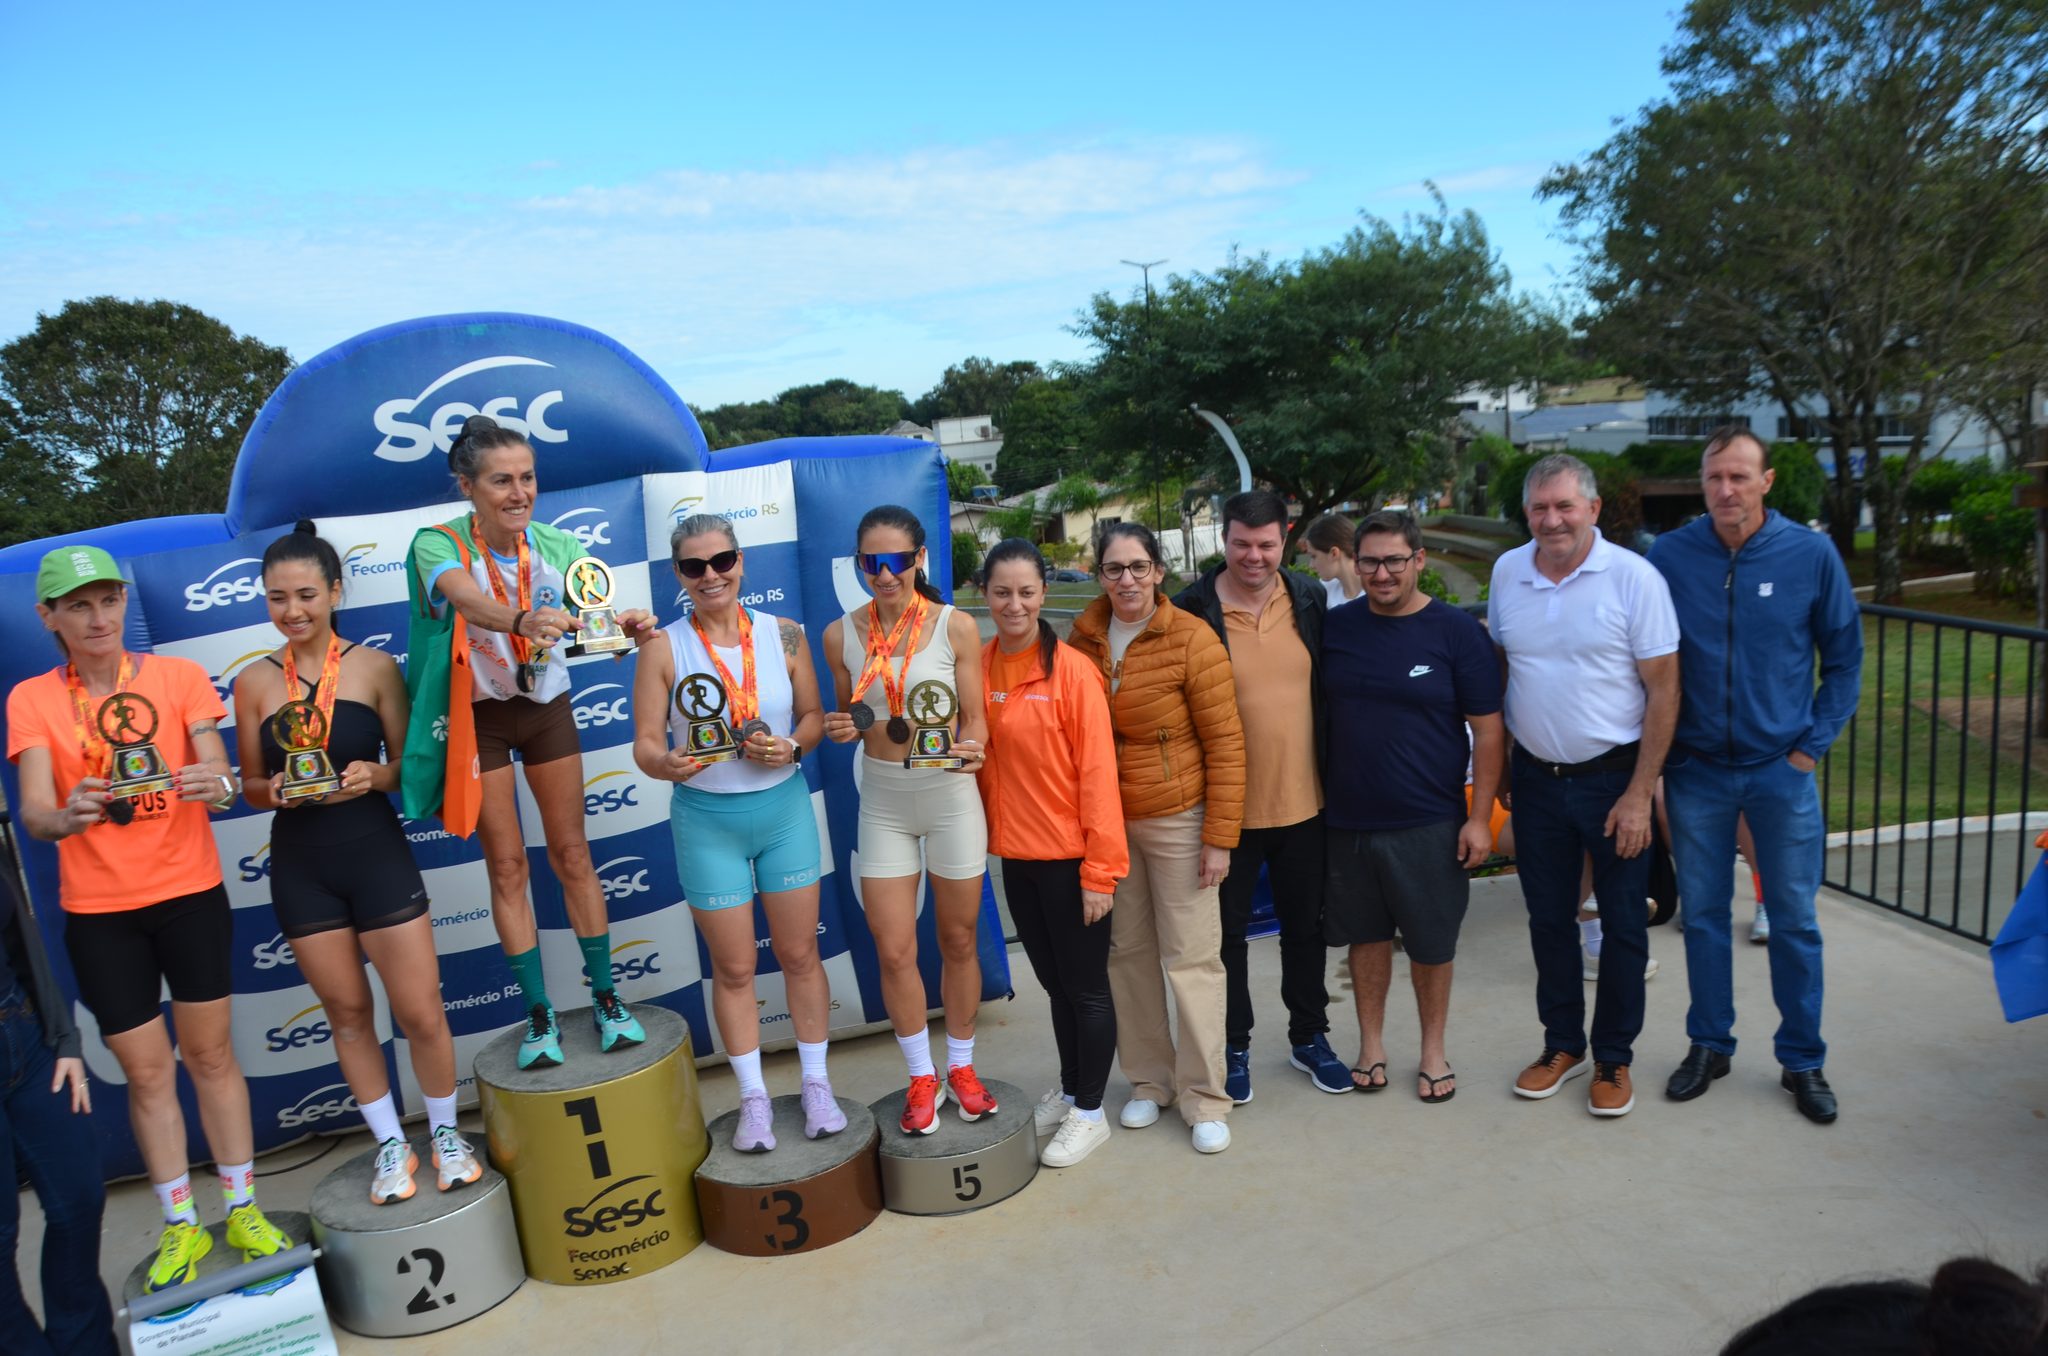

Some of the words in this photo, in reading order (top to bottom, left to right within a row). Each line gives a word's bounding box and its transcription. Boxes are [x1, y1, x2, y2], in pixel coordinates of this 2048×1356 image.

[761, 503, 780, 516] RS
[767, 589, 785, 602] RS
[815, 921, 827, 936] S
[504, 984, 523, 1000] RS
[564, 1096, 612, 1180] 1
[953, 1163, 983, 1202] 5
[563, 1189, 666, 1238] Sesc
[759, 1189, 810, 1251] 3
[568, 1229, 670, 1263] Fecomércio
[397, 1248, 456, 1316] 2
[573, 1262, 630, 1282] Senac
[179, 1310, 221, 1329] Municipal
